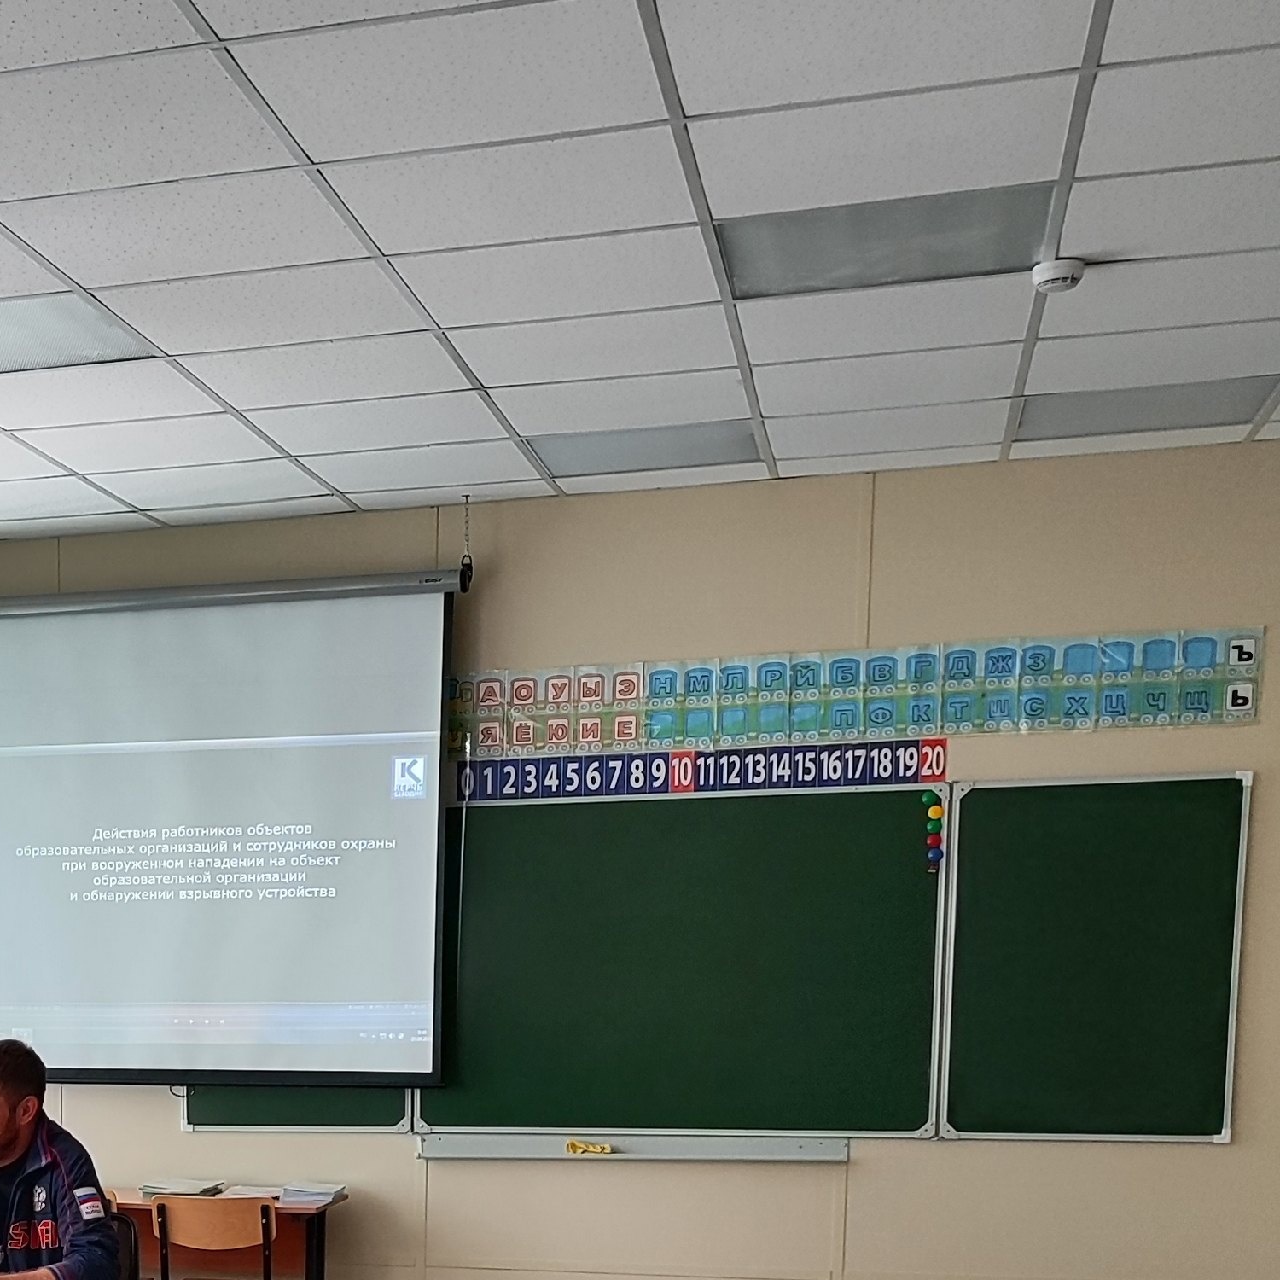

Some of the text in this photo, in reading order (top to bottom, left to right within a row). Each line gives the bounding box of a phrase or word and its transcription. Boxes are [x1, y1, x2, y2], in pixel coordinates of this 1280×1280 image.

[480, 685, 499, 702] А
[515, 682, 533, 702] О
[550, 681, 567, 700] У
[583, 680, 600, 698] Ы
[618, 678, 637, 695] Э
[653, 673, 672, 695] Н
[689, 673, 710, 694] М
[723, 672, 743, 690] Л
[763, 670, 781, 687] Р
[795, 664, 816, 688] Й
[835, 664, 854, 684] Б
[872, 663, 892, 682] В
[989, 654, 1012, 673] Ж
[1027, 653, 1046, 672] З
[1231, 643, 1254, 662] Ъ
[480, 727, 498, 743] Я
[516, 720, 534, 743] Ё
[548, 722, 568, 742] Ю
[581, 721, 601, 739] И
[618, 718, 636, 738] Е
[834, 709, 855, 727] П
[911, 704, 931, 723] К
[1024, 697, 1045, 717] С
[1063, 696, 1088, 716] Х
[1146, 692, 1166, 711] Ч
[1231, 689, 1249, 708] Ь
[462, 745, 944, 795] 0 1 2 3 4 5 6 7 8 9 10 11 12 13 14 15 16 17 18 19 20
[92, 823, 312, 842] Действия работников объектов
[16, 838, 396, 858] образовательных организаций и сотрудников охраны
[62, 853, 341, 873] при вооруженном нападении на объект
[93, 871, 306, 887] образовательной организации
[70, 885, 336, 903] и обнаружении взрывного устройства
